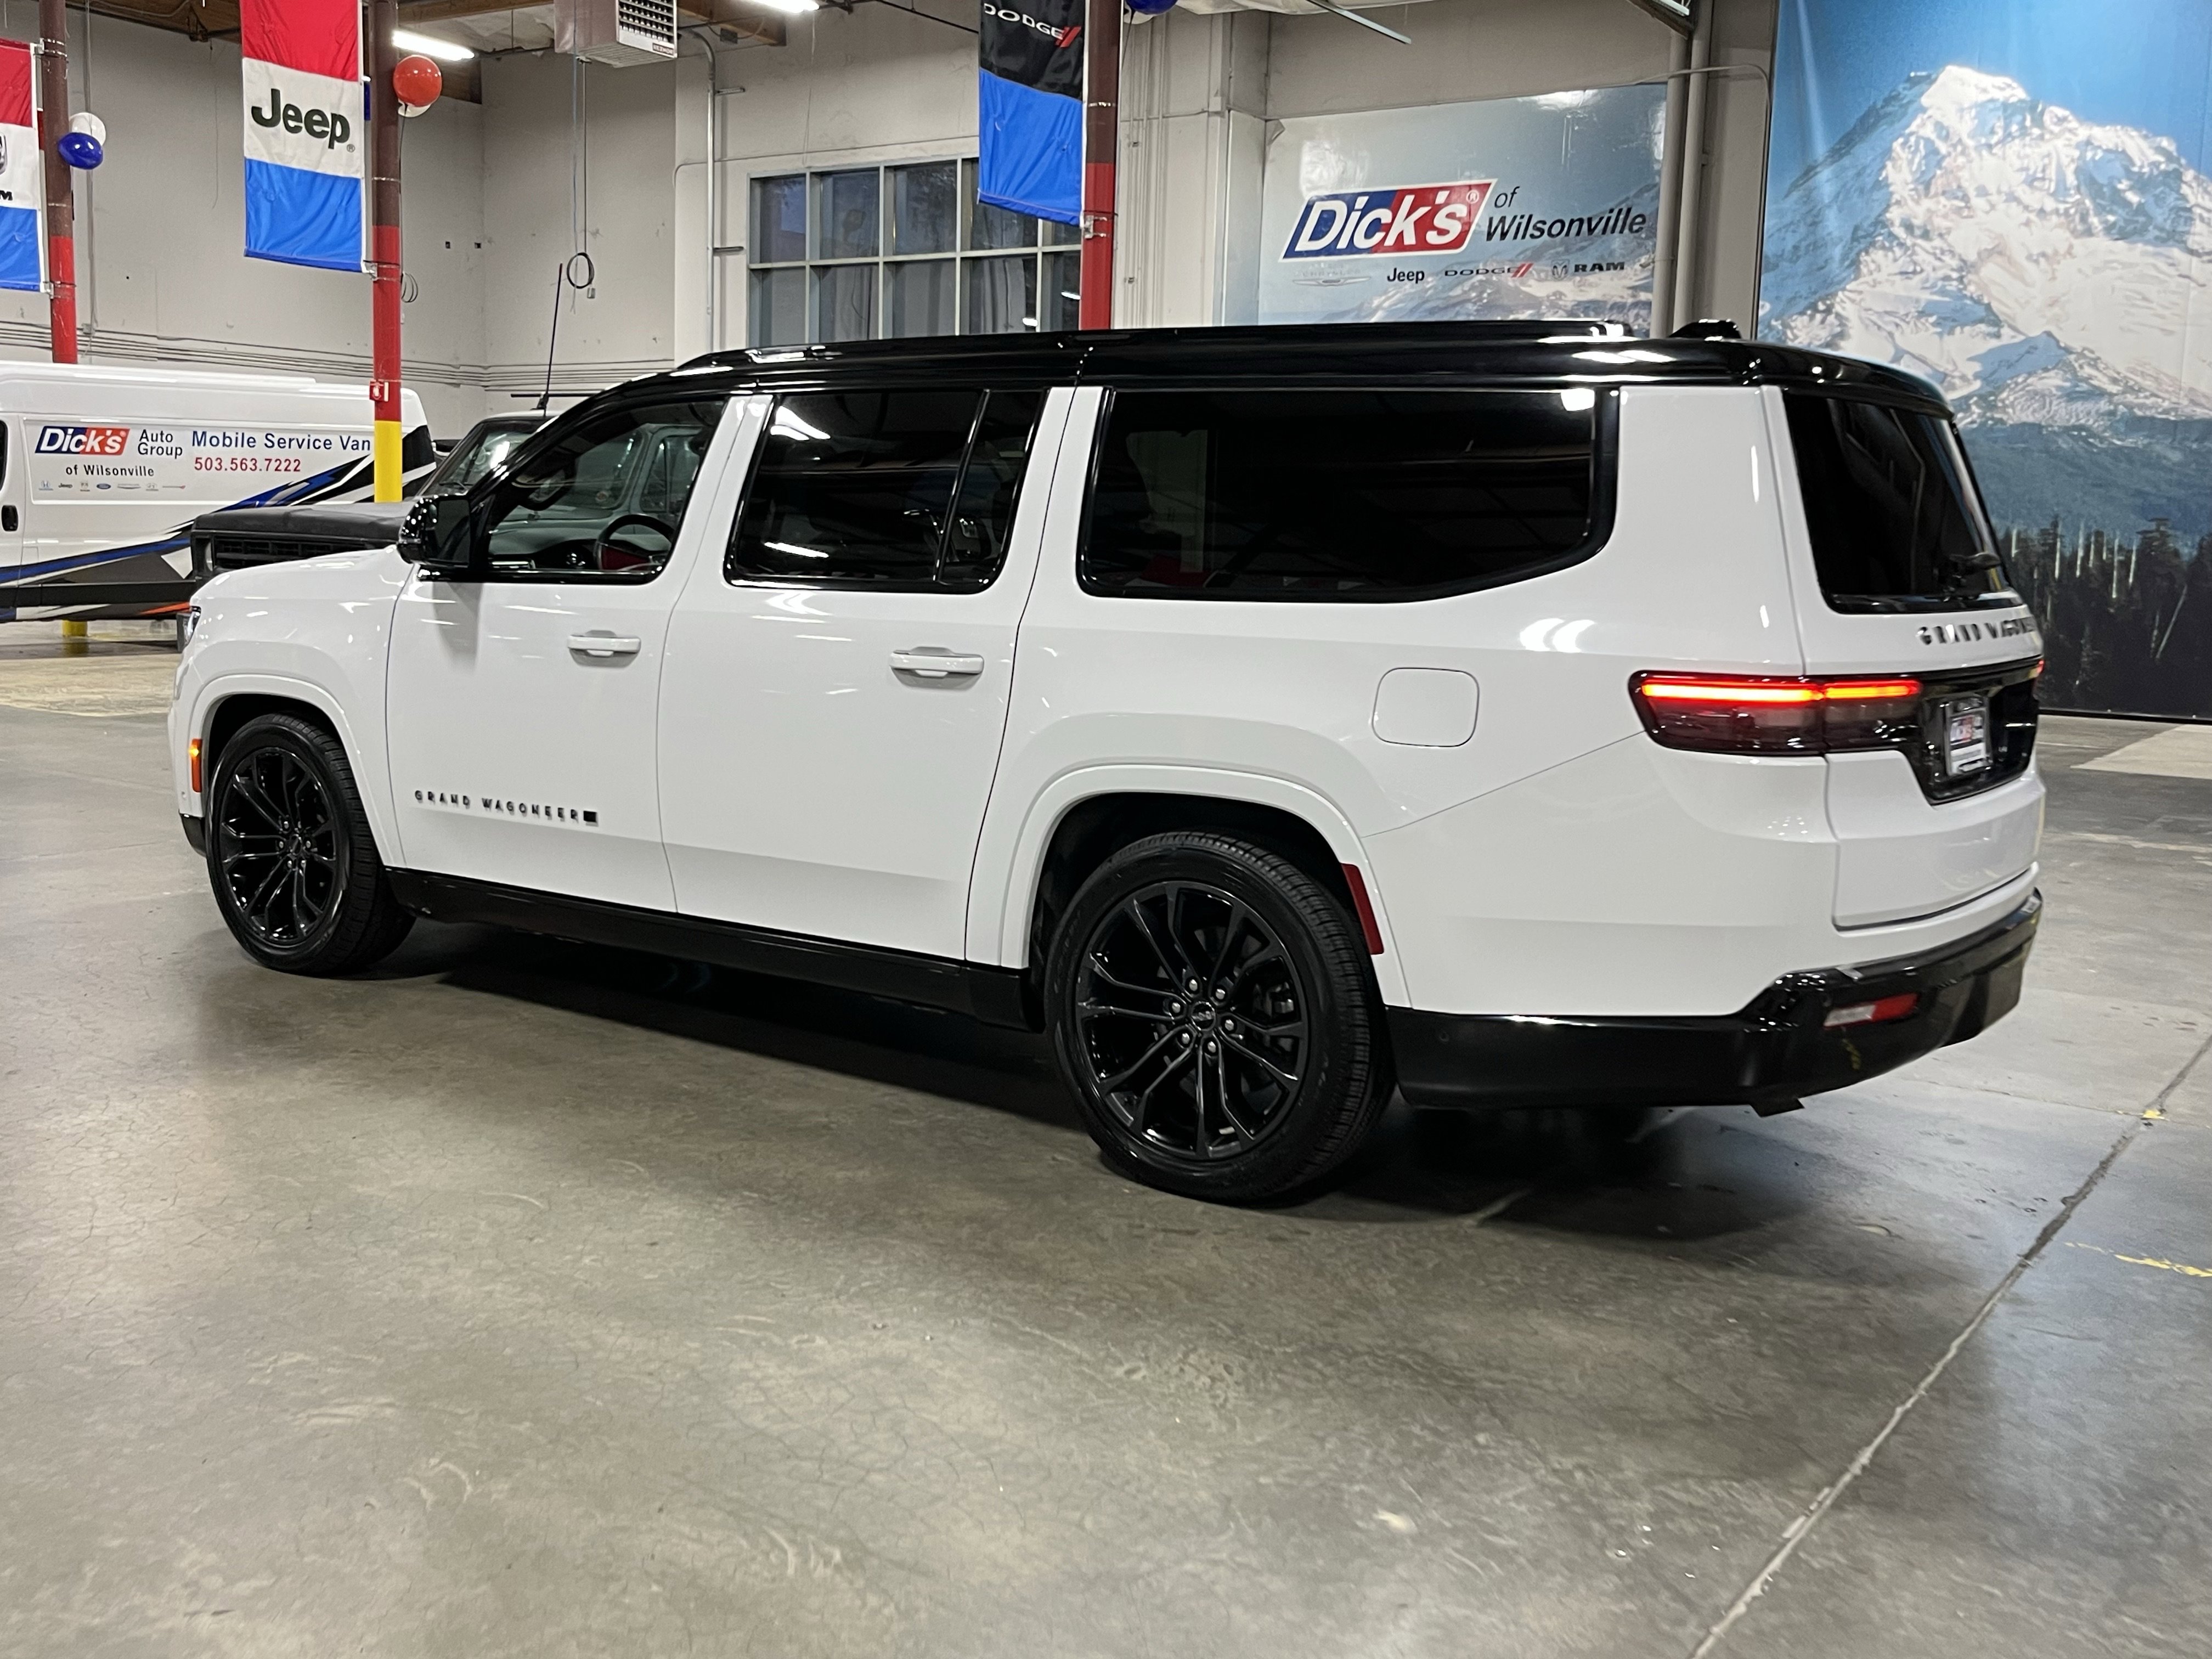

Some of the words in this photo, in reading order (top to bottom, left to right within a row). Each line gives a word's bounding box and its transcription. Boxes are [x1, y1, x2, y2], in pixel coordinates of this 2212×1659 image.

[984, 3, 1065, 41] DODGE
[251, 88, 351, 150] Jeep
[1494, 185, 1520, 208] of
[1486, 205, 1646, 242] Wilsonville
[1387, 268, 1425, 284] Jeep
[1444, 267, 1515, 276] DODGE
[1573, 262, 1626, 273] RAM
[139, 429, 173, 443] Auto
[191, 430, 257, 448] Mobile
[264, 432, 333, 450] Service
[339, 435, 371, 451] Van
[137, 443, 183, 459] Group
[65, 464, 78, 476] of
[83, 464, 154, 477] Wilsonville
[194, 456, 302, 472] 503.563.7222
[414, 790, 471, 806] GRAND
[481, 797, 579, 821] WAGONEER
